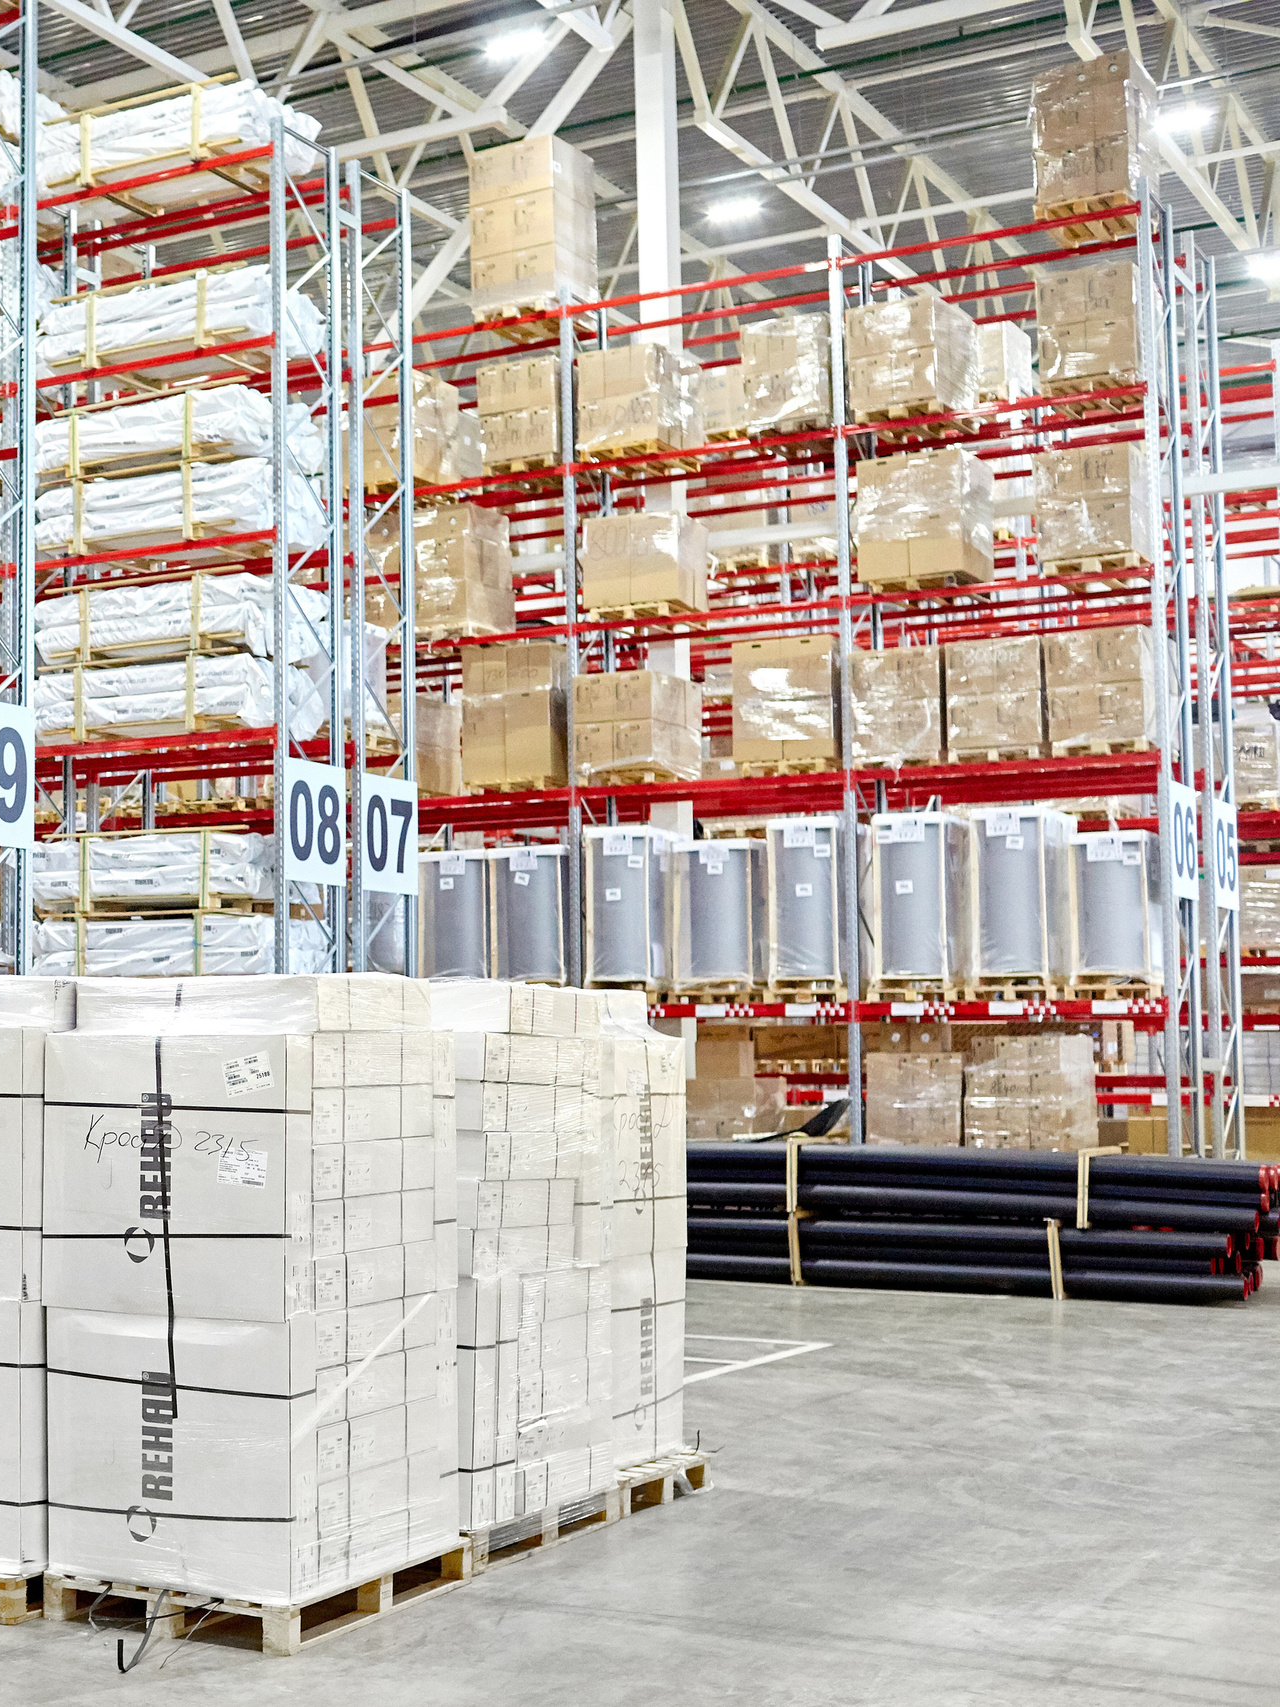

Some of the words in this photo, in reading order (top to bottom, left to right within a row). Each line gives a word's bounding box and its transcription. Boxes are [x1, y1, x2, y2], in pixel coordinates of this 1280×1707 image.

[289, 780, 341, 865] 08
[366, 795, 413, 874] 07
[1174, 802, 1195, 881] 06
[1216, 818, 1236, 892] 05
[140, 1093, 172, 1220] REHAU
[194, 1131, 259, 1162] 2315
[640, 1297, 653, 1396] REHAU
[141, 1371, 173, 1501] REHAU
